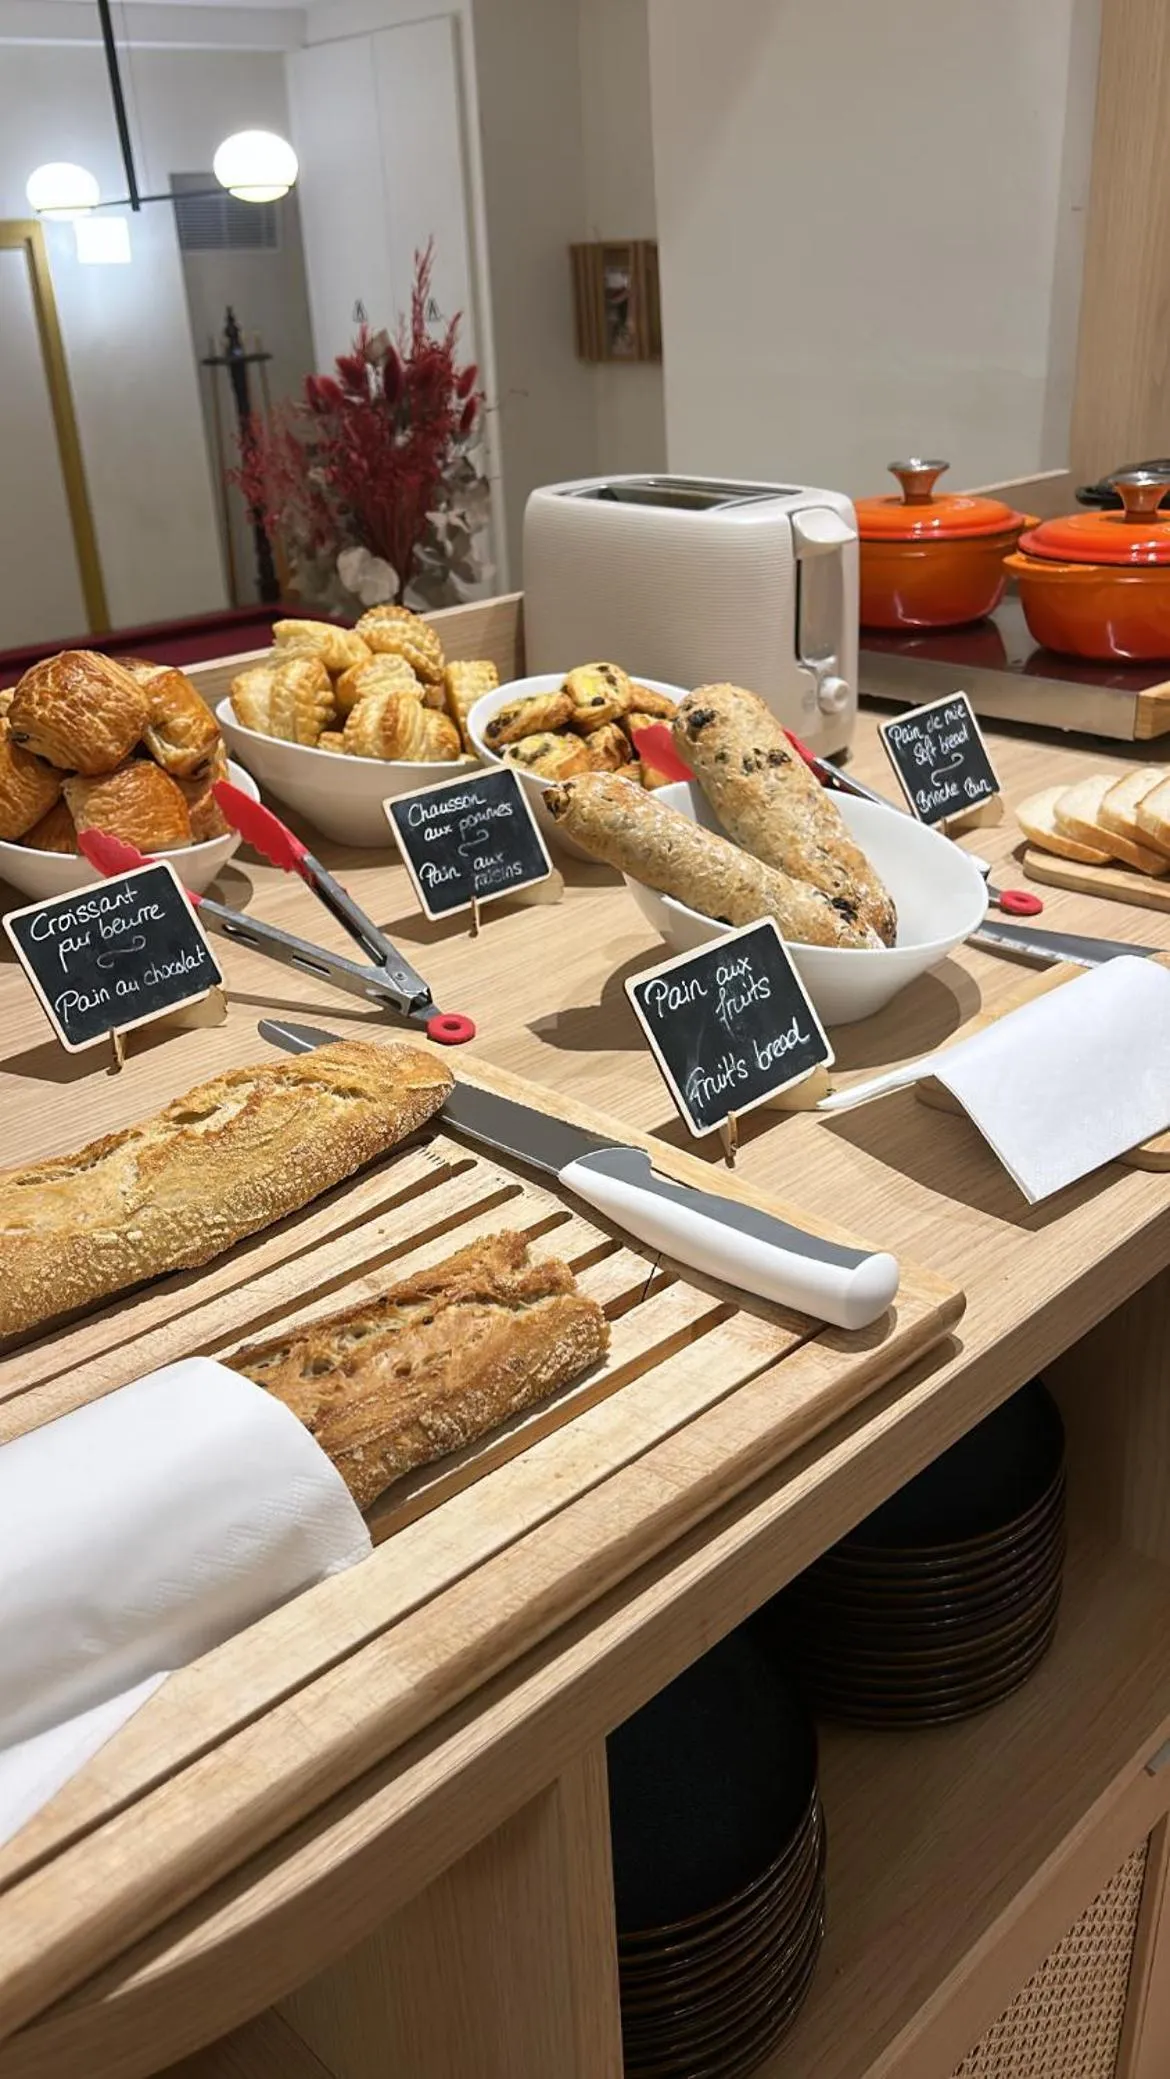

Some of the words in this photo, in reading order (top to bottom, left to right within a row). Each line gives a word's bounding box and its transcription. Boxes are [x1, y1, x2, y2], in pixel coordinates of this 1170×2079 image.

[888, 724, 924, 750] Pain
[926, 714, 943, 733] de
[944, 704, 967, 725] mie
[913, 734, 937, 767] Soft
[938, 721, 969, 755] bread
[408, 793, 487, 827] Chausson
[963, 777, 993, 798] Bun
[424, 825, 452, 842] aux
[459, 802, 513, 841] pommes
[419, 862, 461, 888] Pain
[473, 852, 503, 870] aux
[474, 862, 523, 890] raisins
[30, 882, 138, 941] Croissant
[58, 931, 91, 973] pur
[100, 903, 166, 939] beurre
[55, 988, 110, 1023] Pain
[116, 977, 140, 995] au
[143, 944, 206, 986] chocolat
[644, 979, 708, 1018] Pain
[716, 957, 752, 986] aux
[715, 974, 771, 1038] fruits
[753, 1016, 810, 1071] bread
